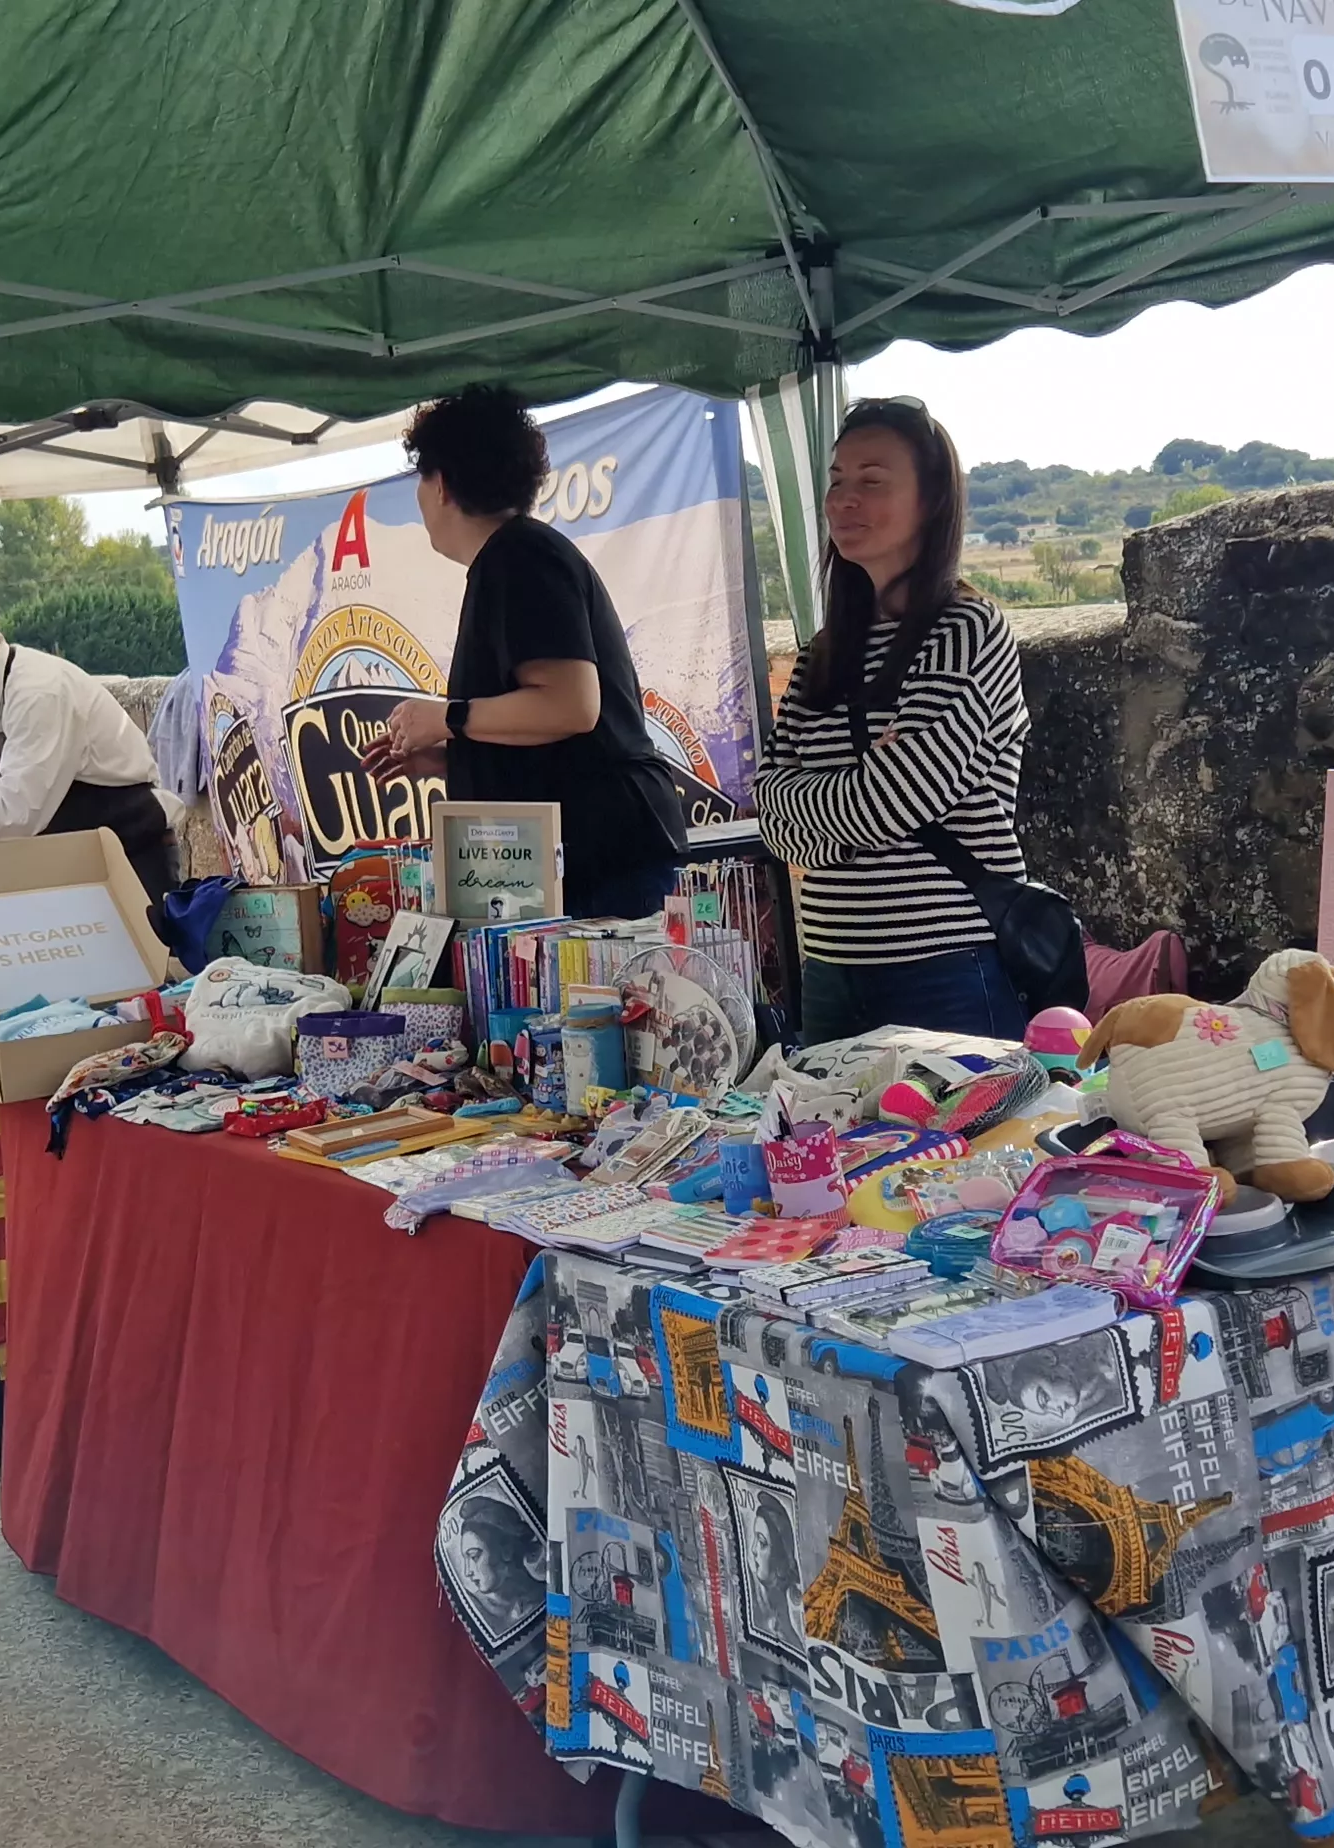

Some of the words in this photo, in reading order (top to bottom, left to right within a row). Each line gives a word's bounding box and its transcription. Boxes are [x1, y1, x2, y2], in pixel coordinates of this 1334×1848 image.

[531, 455, 618, 526] eos
[196, 503, 285, 576] Aragón
[330, 571, 372, 592] ARAGÓN
[293, 615, 340, 700] Quesos
[344, 605, 442, 697] Artesanos
[340, 708, 391, 760] Que
[642, 687, 707, 767] Curado
[290, 704, 448, 856] Guar
[458, 848, 488, 860] LIVE
[492, 848, 533, 861] YOUR
[458, 869, 535, 889] dream
[696, 902, 714, 915] 2€
[17, 944, 85, 966] HERE!
[721, 1157, 751, 1176] nie
[768, 1152, 803, 1171] Daisy
[485, 1391, 518, 1417] TOUR
[787, 1385, 820, 1408] EIFFEL
[548, 1403, 571, 1459] Paris
[792, 1435, 821, 1452] TOUR
[995, 1411, 1028, 1448] 370
[1217, 1393, 1235, 1451] EIFFEL
[1159, 1410, 1197, 1526] EIFFEL
[1191, 1401, 1222, 1492] EIFFEL
[793, 1446, 861, 1494] EIFFEL
[733, 1477, 756, 1511] 370
[924, 1525, 969, 1587] Paris
[982, 1618, 1072, 1663] PARIS
[1150, 1626, 1196, 1674] Paris
[650, 1671, 683, 1692] EIFFEL
[594, 1684, 645, 1732] METRO
[652, 1692, 707, 1728] EIFFEL
[653, 1727, 720, 1771] EIFFEL
[868, 1729, 907, 1752] PARIS
[1123, 1732, 1168, 1768] EIFFEL
[1126, 1743, 1200, 1794] EIFFEL
[1130, 1768, 1224, 1828] EIFFEL
[1040, 1812, 1116, 1831] METRO
